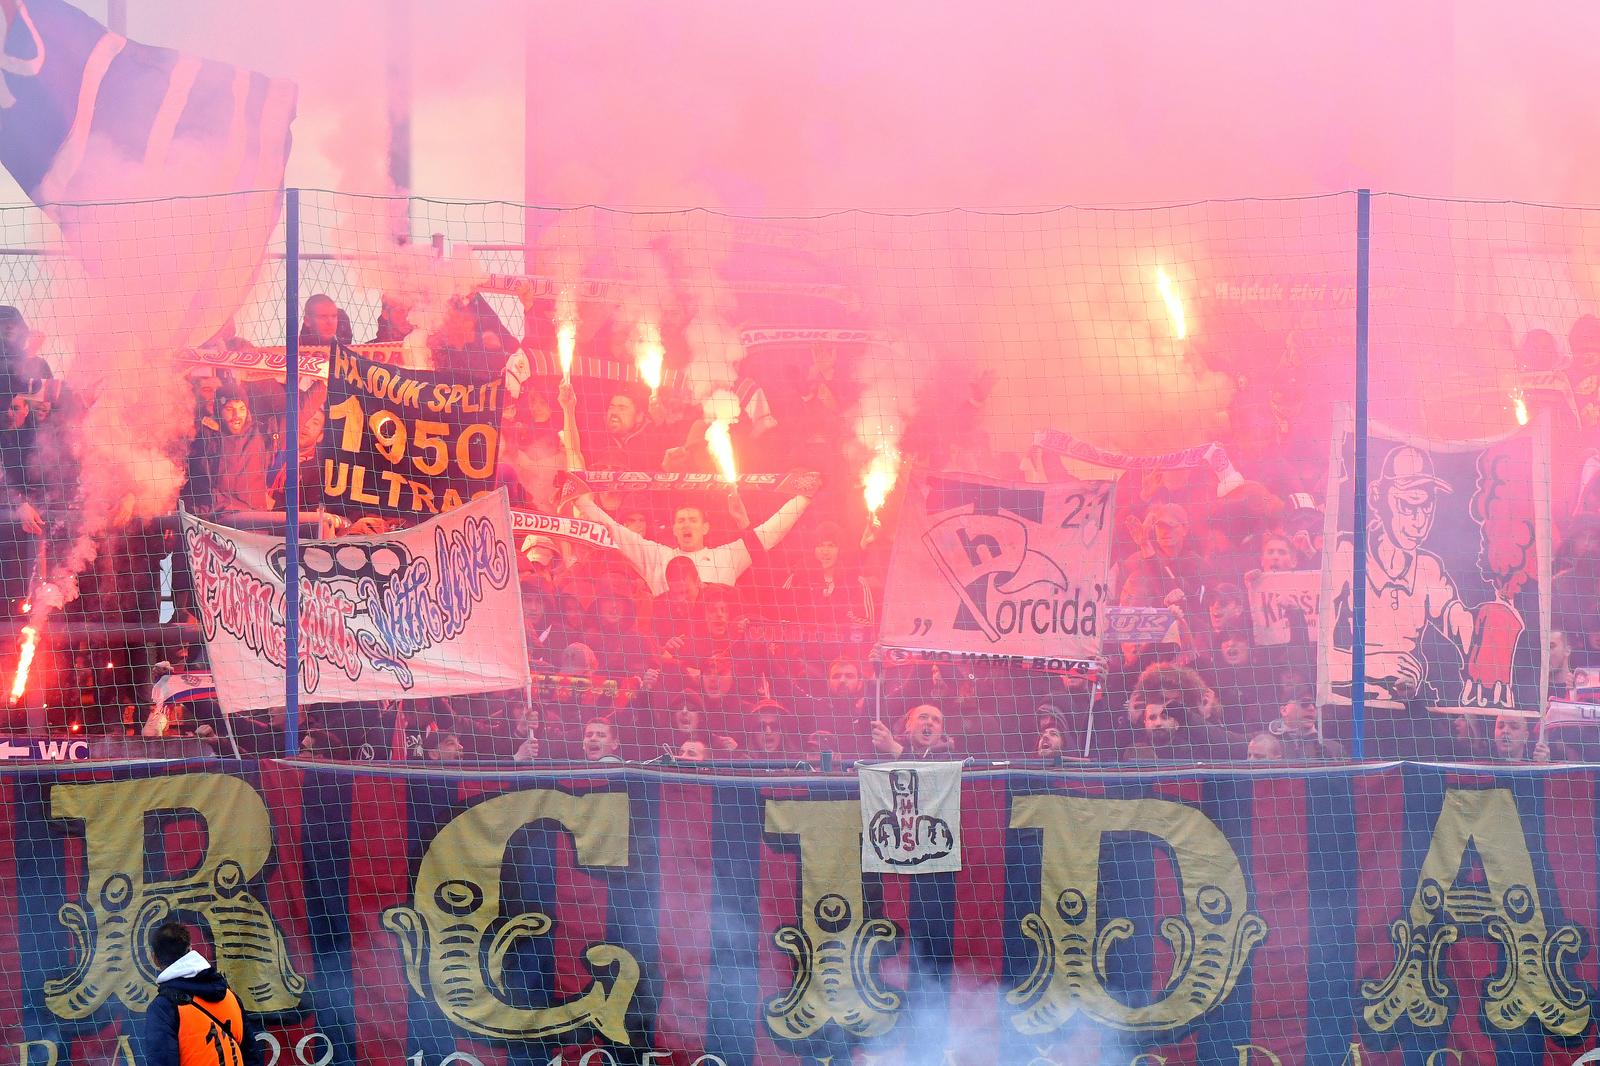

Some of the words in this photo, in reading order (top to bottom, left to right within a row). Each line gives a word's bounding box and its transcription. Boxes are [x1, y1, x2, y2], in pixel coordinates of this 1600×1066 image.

[427, 378, 503, 413] SPLIT
[329, 395, 498, 480] 1950
[324, 458, 489, 514] ULTRA
[1032, 656, 1090, 675] BOYS
[38, 741, 88, 760] WC
